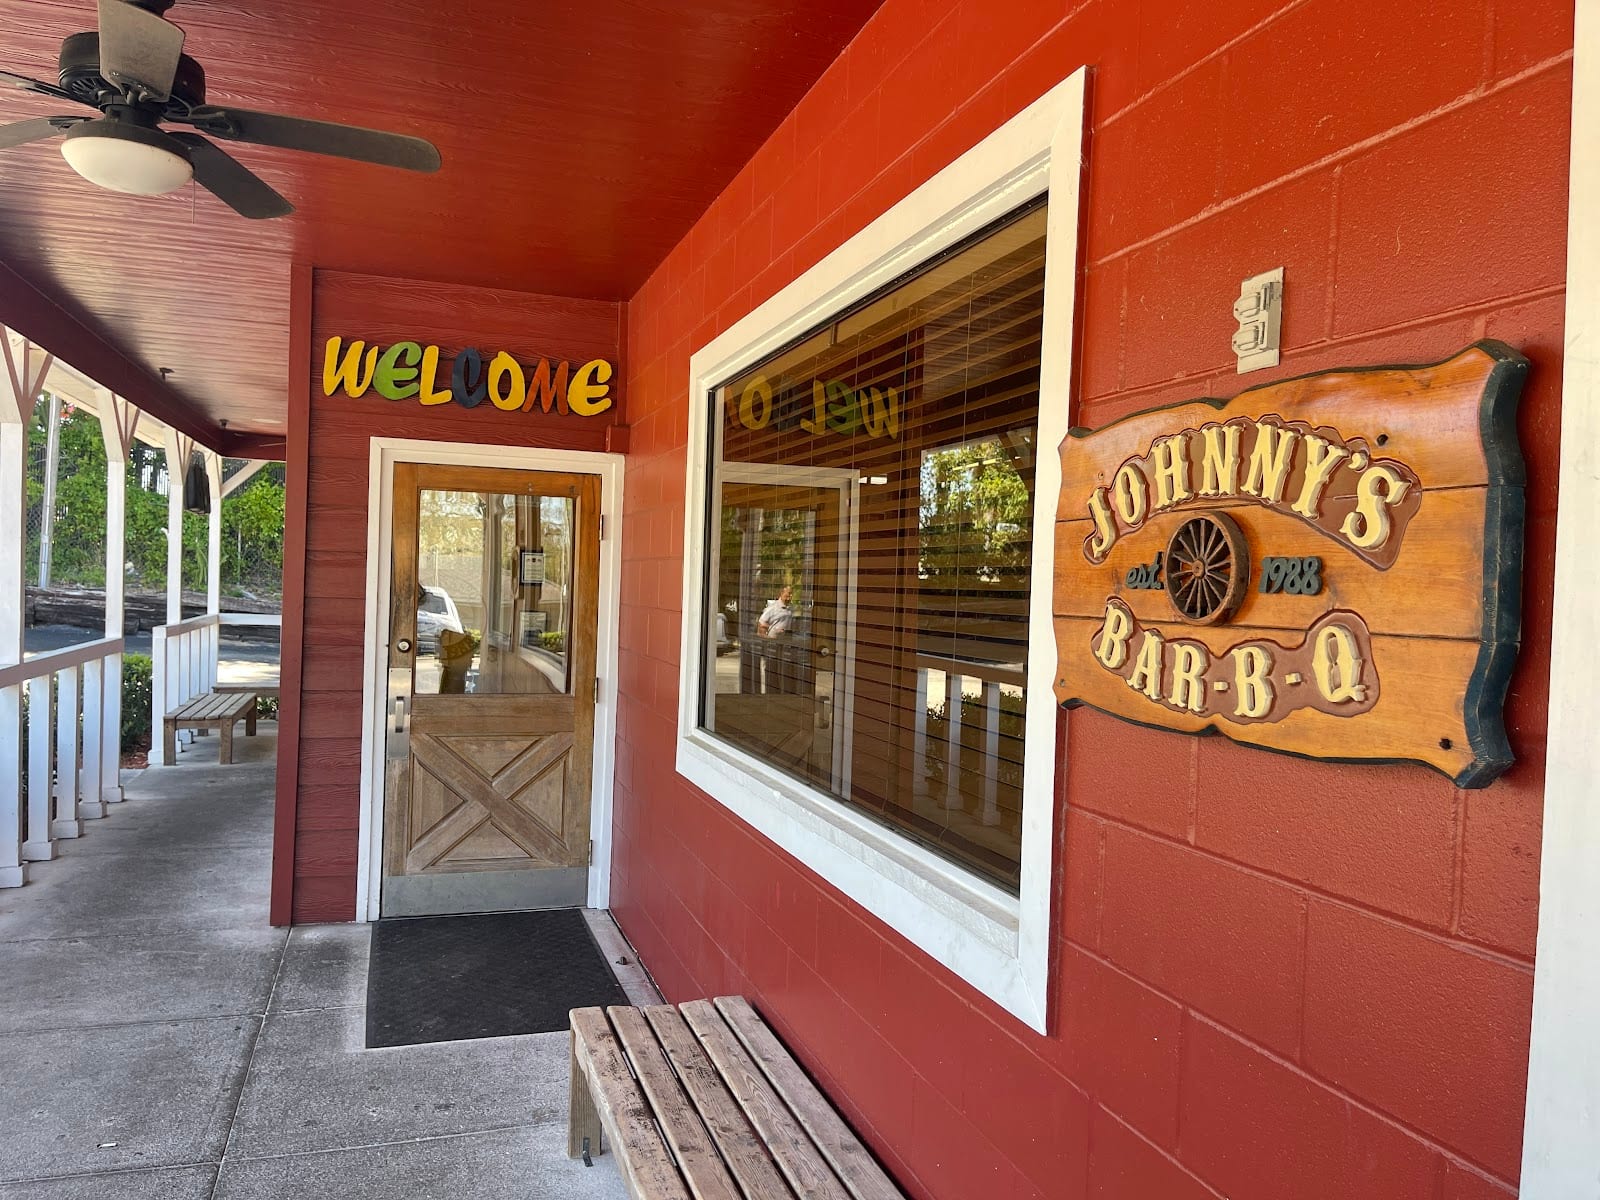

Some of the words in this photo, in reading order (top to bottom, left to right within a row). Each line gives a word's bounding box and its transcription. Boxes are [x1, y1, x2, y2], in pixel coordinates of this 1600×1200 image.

[323, 336, 612, 416] WELCOME
[1087, 423, 1411, 558] JOHNNY'S
[1126, 552, 1165, 590] est.
[1258, 556, 1323, 596] 1988
[1095, 603, 1367, 718] BAR-B-Q
